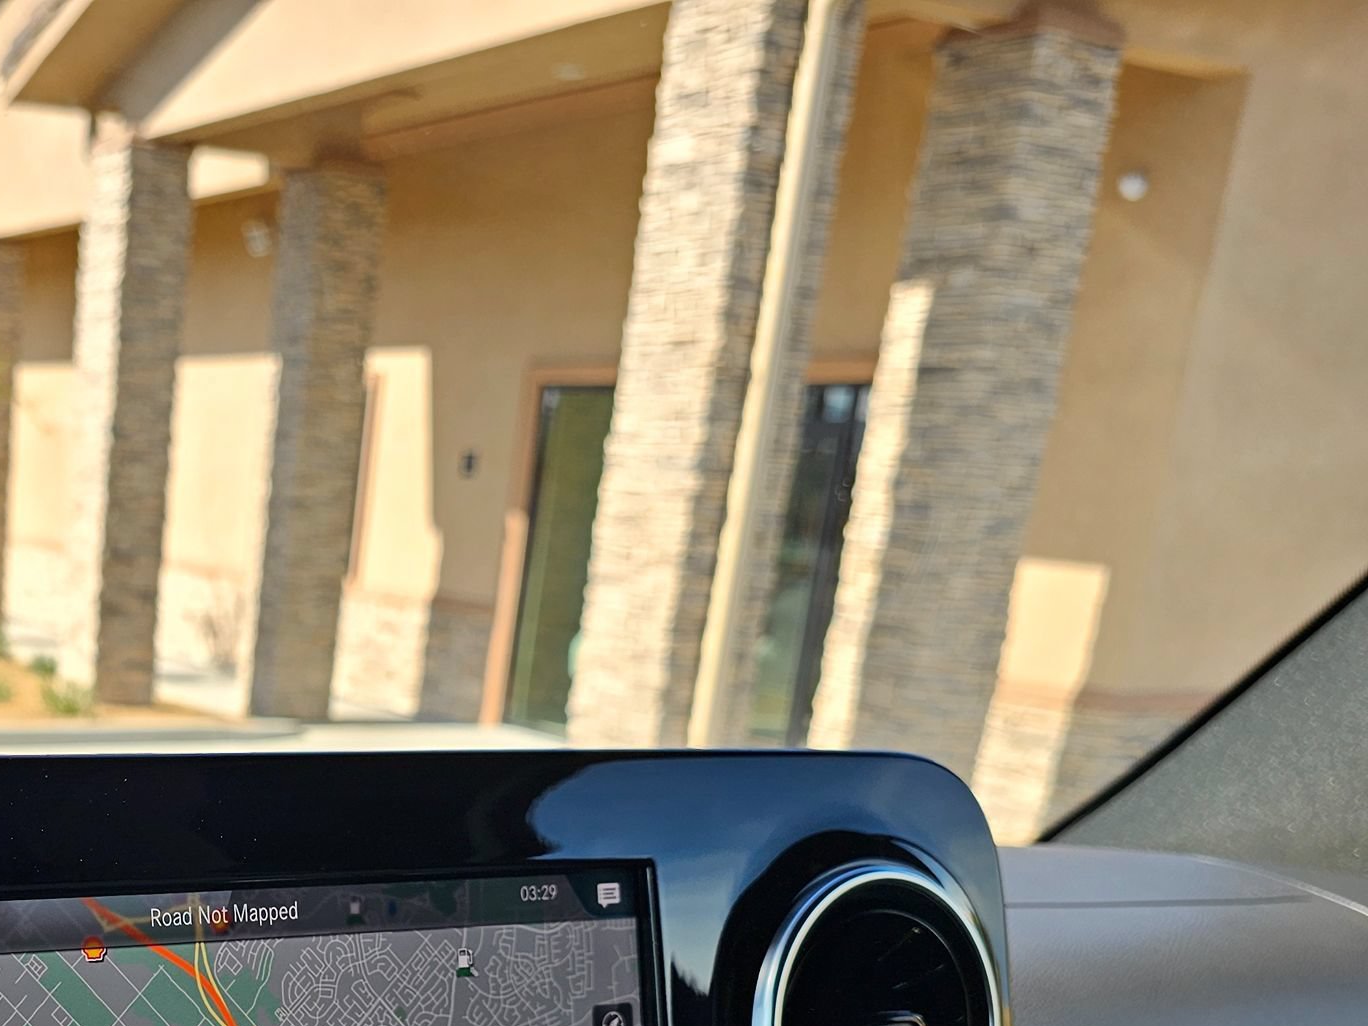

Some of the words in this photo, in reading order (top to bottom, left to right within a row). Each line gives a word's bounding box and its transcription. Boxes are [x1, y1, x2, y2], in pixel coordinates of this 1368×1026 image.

[520, 884, 558, 902] 03:29
[150, 906, 193, 927] Road
[198, 905, 229, 925] Not
[233, 900, 299, 927] Mapped
